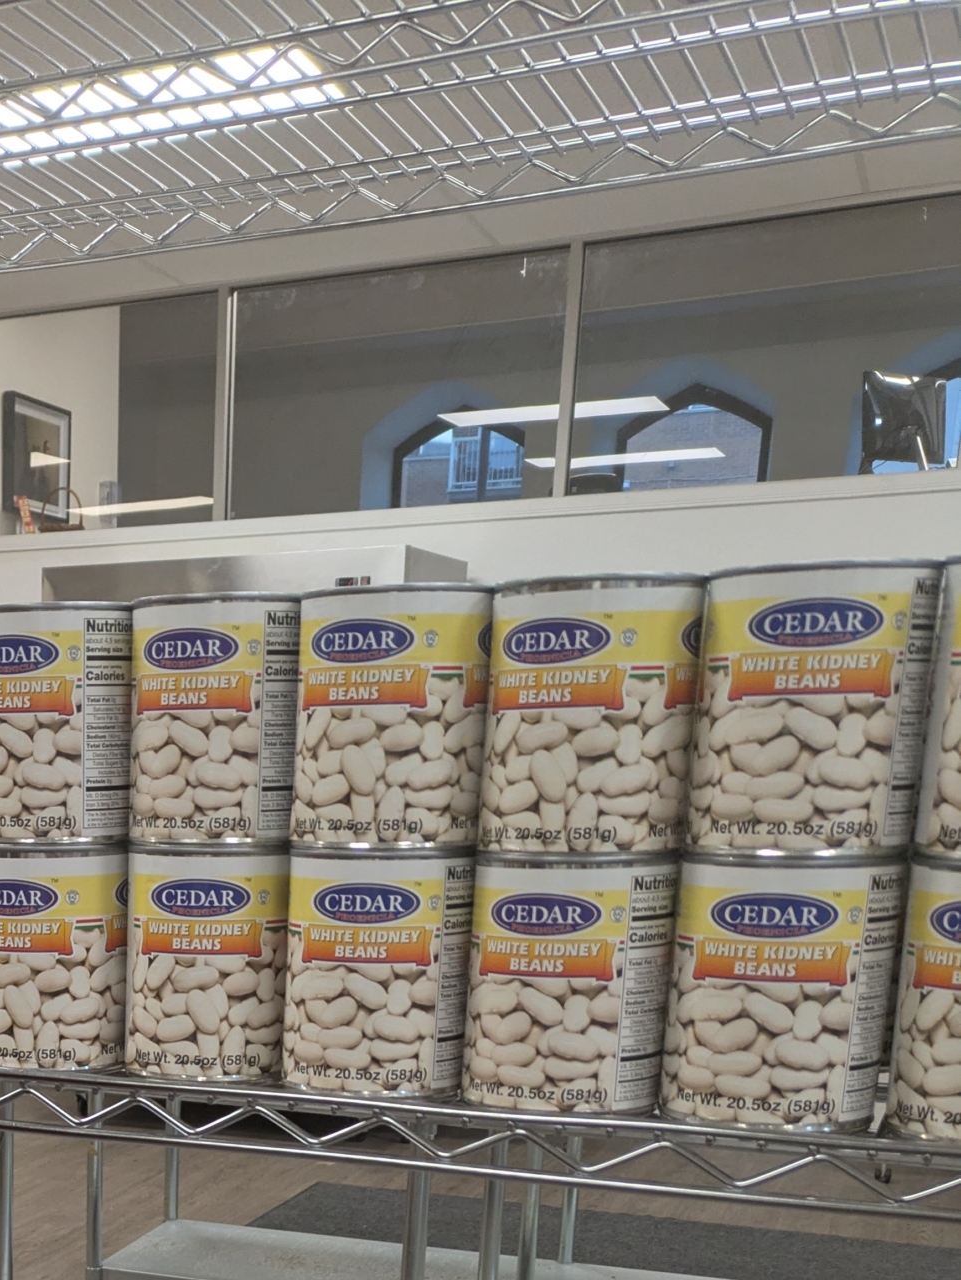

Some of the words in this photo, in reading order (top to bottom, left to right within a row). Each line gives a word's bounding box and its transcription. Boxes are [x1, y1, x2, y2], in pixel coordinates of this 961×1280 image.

[762, 609, 866, 635] CEDAR
[320, 631, 399, 652] CEDAR
[510, 630, 592, 652] CEDAR
[151, 639, 224, 660] CEDAR
[741, 655, 800, 672] WHITE
[805, 653, 882, 670] KIDNEY
[86, 671, 125, 682] Calories
[142, 677, 177, 690] WHITE
[181, 676, 240, 690] KIDNEY
[309, 670, 346, 684] WHITE
[352, 668, 415, 684] KIDNEY
[498, 672, 538, 688] WHITE
[542, 668, 610, 685] KIDNEY
[774, 673, 842, 690] BEANS
[6, 680, 61, 694] KIDNEY
[329, 686, 379, 701] BEANS
[160, 692, 208, 706] BEANS
[518, 688, 572, 704] BEANS
[711, 821, 733, 835] Net
[738, 821, 762, 835] Wt.
[766, 822, 824, 836] 20.5oz
[829, 821, 878, 838] (581g)
[162, 889, 236, 906] CEDAR
[324, 893, 405, 913] CEDAR
[501, 904, 583, 924] CEDAR
[724, 904, 820, 926] CEDAR
[7, 922, 60, 934] KIDNEY
[148, 922, 189, 936] WHITE
[194, 923, 252, 936] KIDNEY
[310, 928, 355, 942] WHITE
[358, 930, 420, 944] KIDNEY
[172, 938, 221, 950] BEANS
[630, 930, 668, 944] Calories
[334, 944, 388, 958] BEANS
[487, 939, 529, 955] WHITE
[534, 941, 600, 957] KIDNEY
[704, 942, 758, 959] WHITE
[764, 945, 838, 961] KIDNEY
[509, 958, 564, 972] BEANS
[734, 962, 796, 978] BEANS
